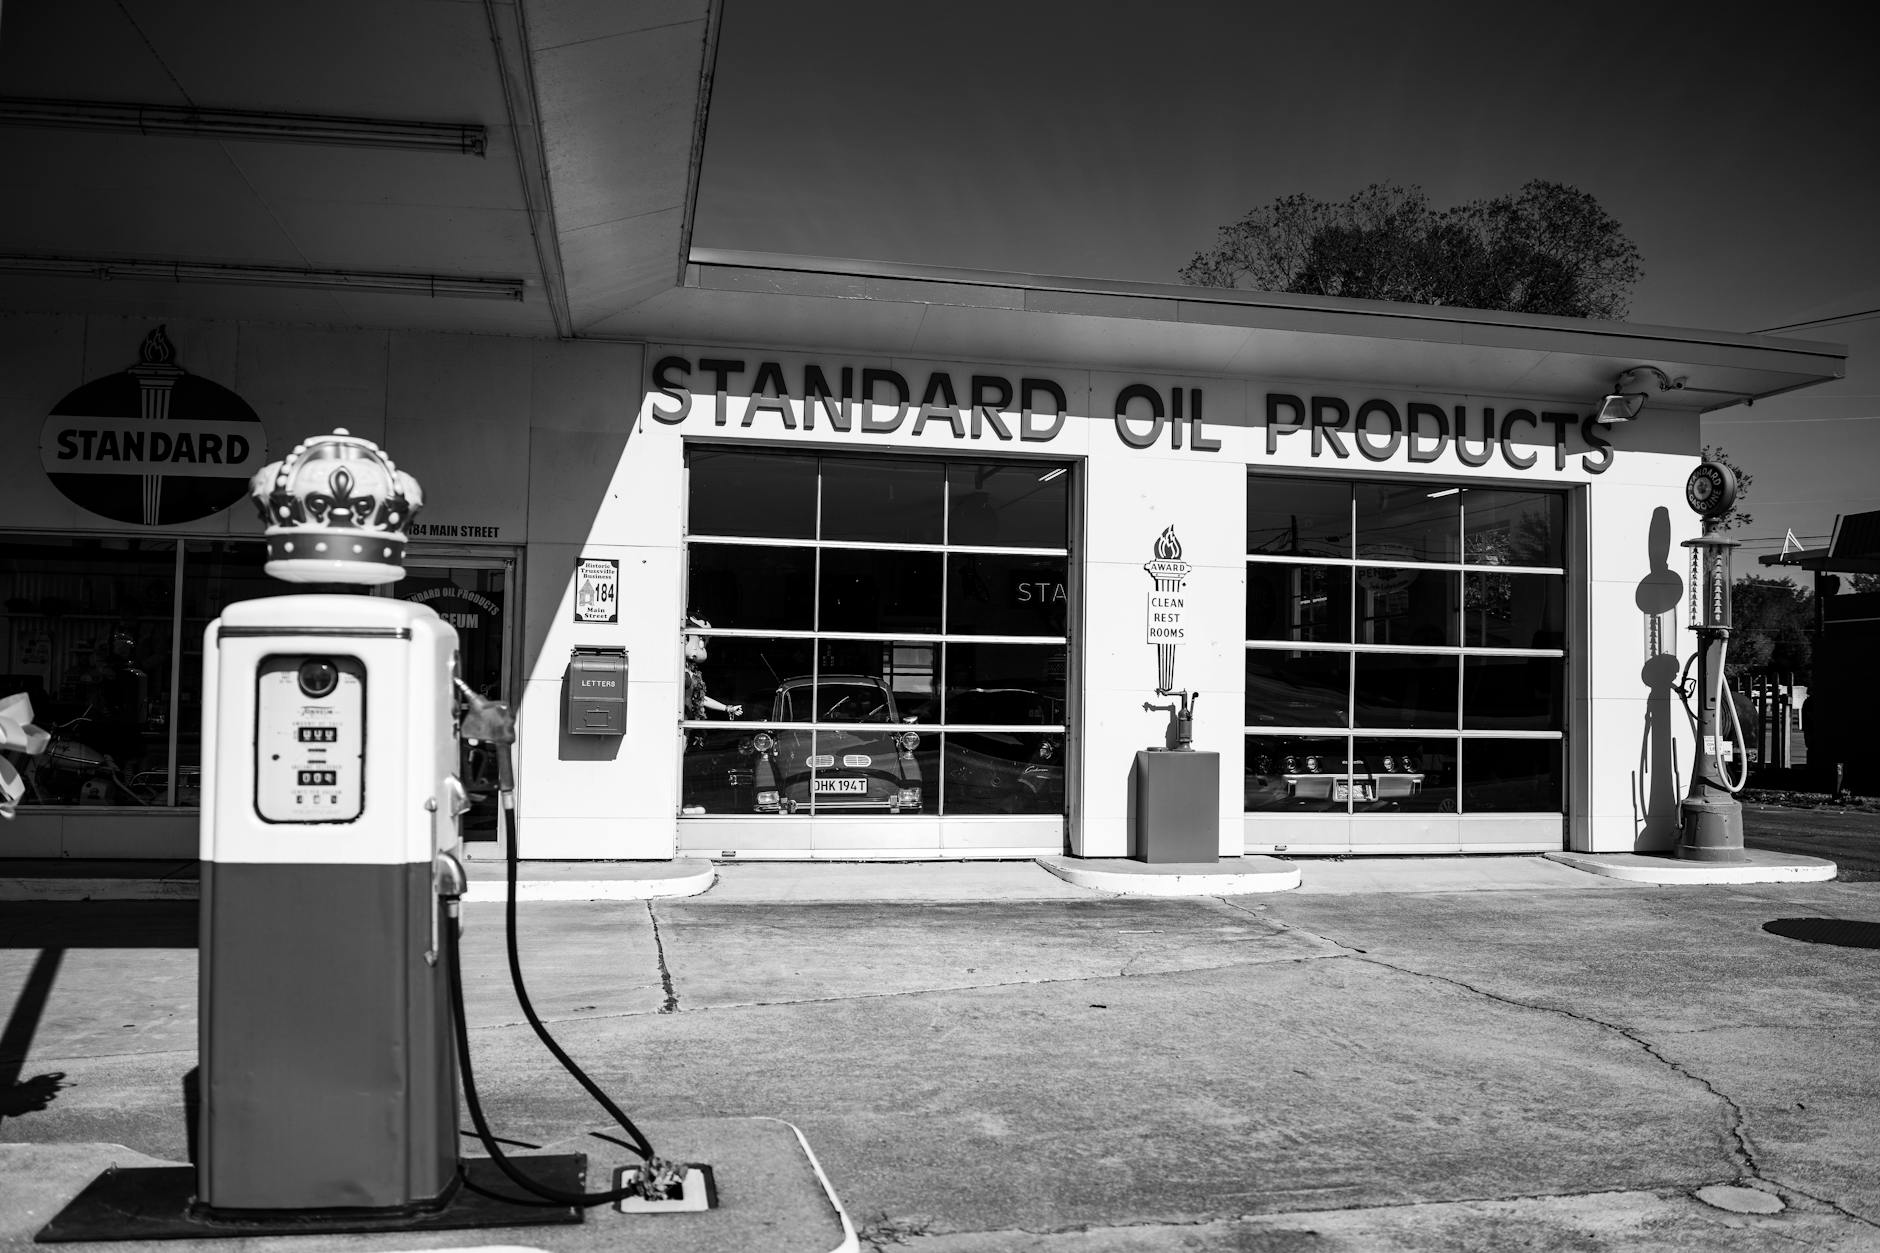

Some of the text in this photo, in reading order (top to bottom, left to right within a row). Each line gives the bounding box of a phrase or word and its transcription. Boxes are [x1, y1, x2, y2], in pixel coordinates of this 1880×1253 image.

[652, 356, 1614, 474] STANDARD OIL PRODUCTS
[57, 429, 249, 465] STANDARD
[1689, 489, 1722, 510] GASOLINE
[408, 524, 500, 538] 184 MAIN STREET
[1151, 563, 1185, 572] AWARD
[595, 583, 614, 602] 184
[408, 587, 500, 616] NDARD OIL PRODUCTS
[1151, 597, 1184, 608] CLEAN
[1154, 613, 1181, 622] REST
[1150, 627, 1184, 638] ROOMS
[581, 680, 616, 688] LETTERS
